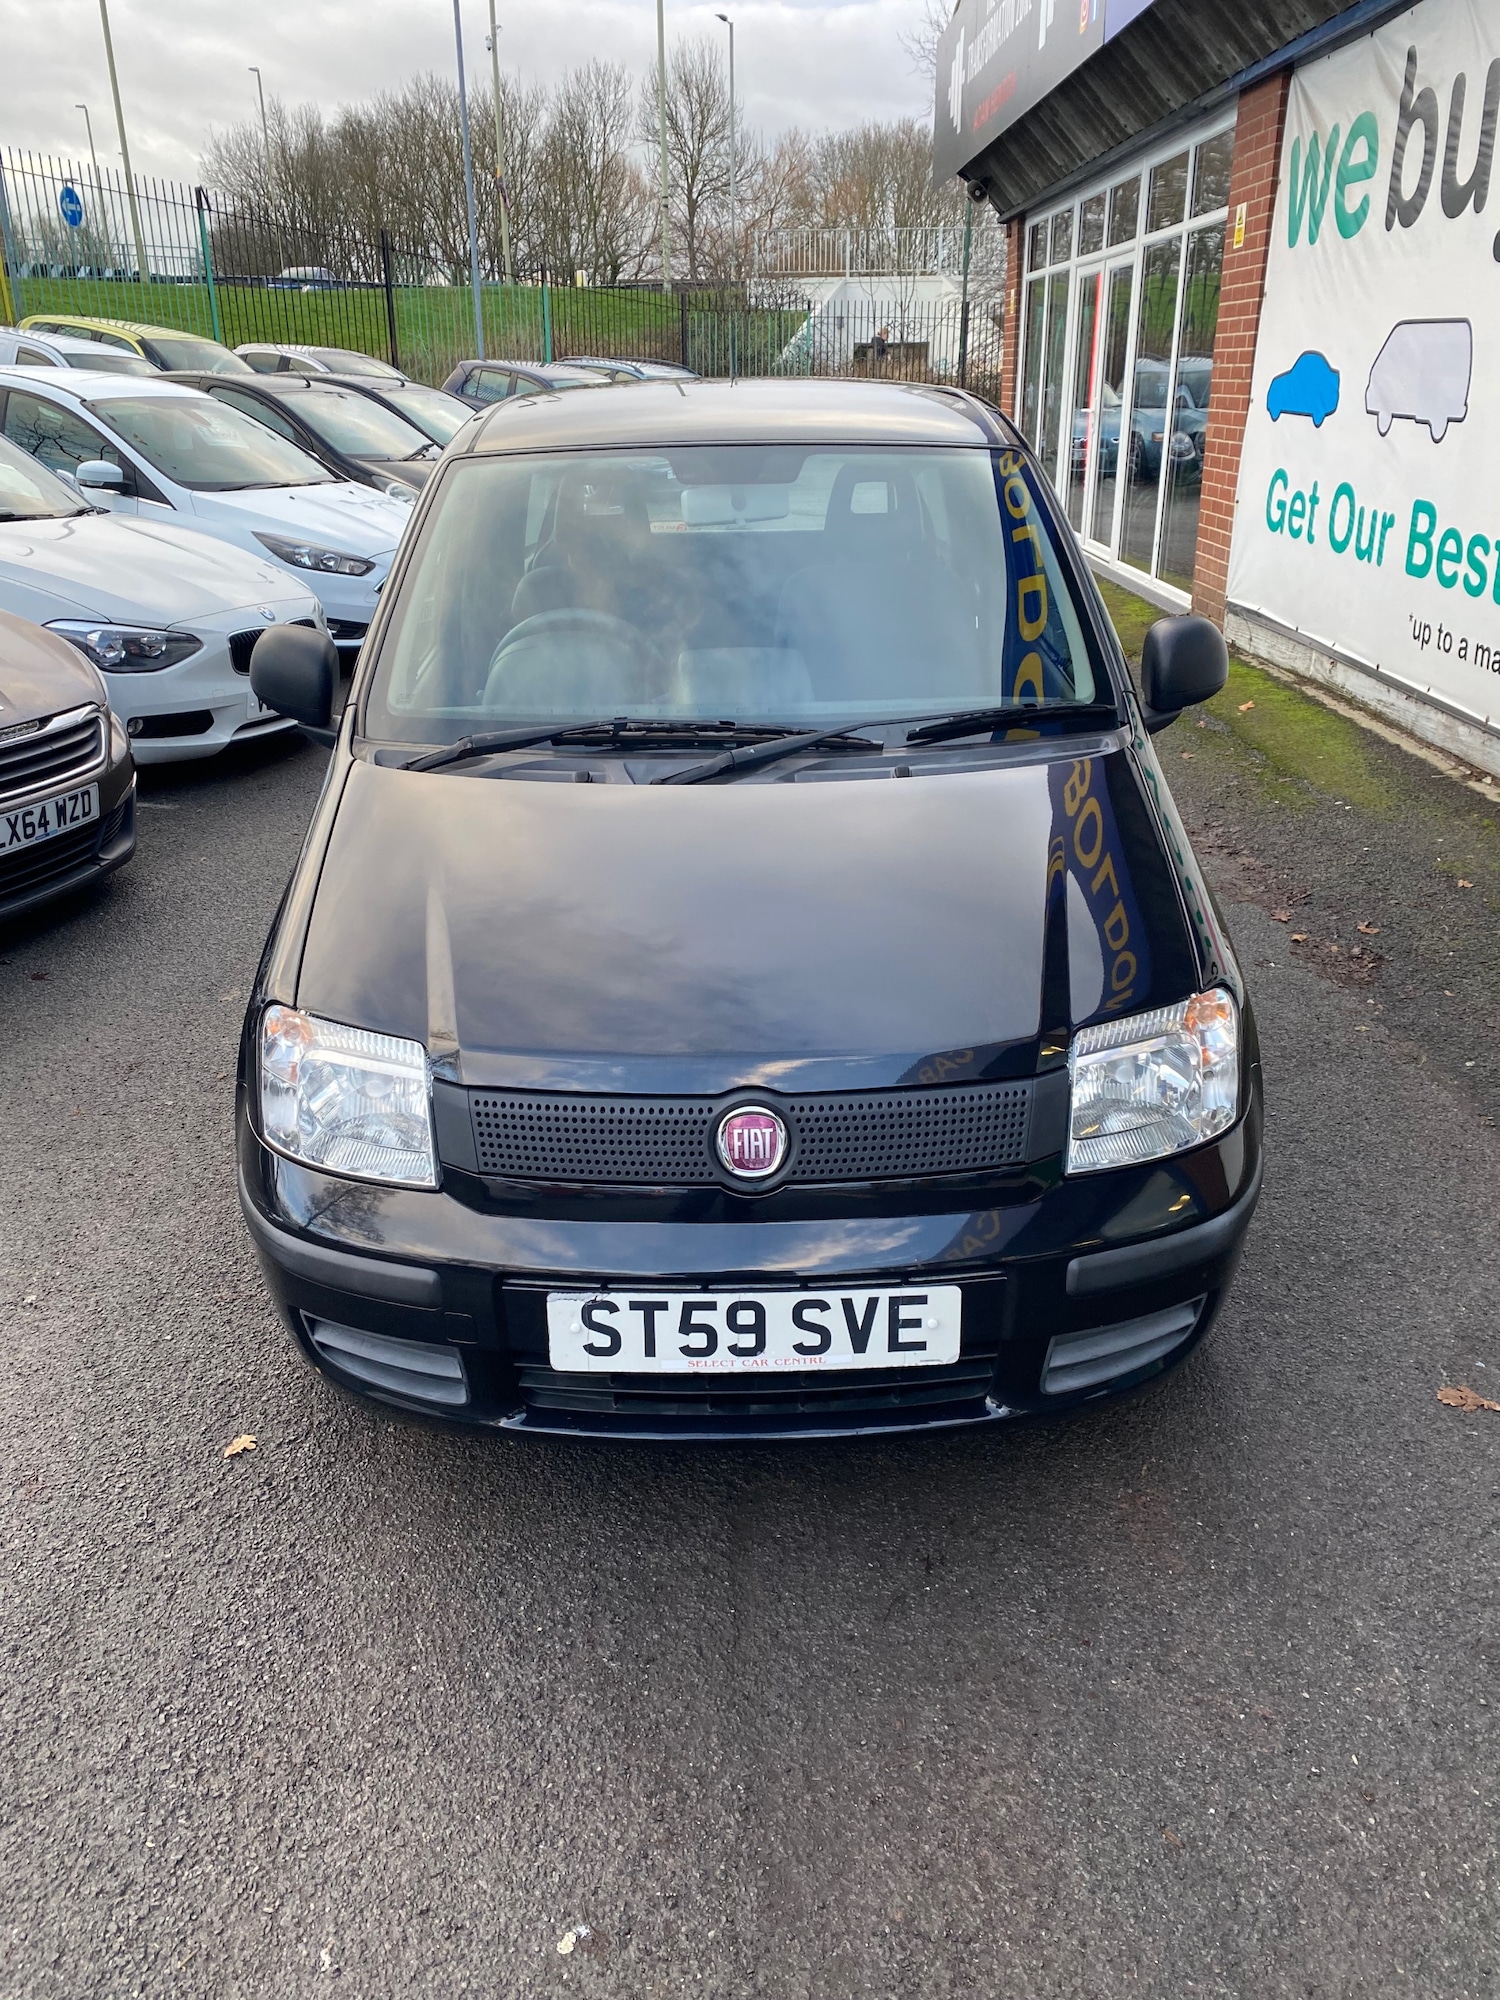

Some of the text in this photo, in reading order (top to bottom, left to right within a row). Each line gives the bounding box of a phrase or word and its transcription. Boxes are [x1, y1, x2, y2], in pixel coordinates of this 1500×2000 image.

[1385, 45, 1500, 262] bu
[1266, 467, 1320, 545] Get
[1328, 481, 1396, 567] Our
[1437, 622, 1453, 654] to
[1458, 636, 1469, 662] a
[55, 789, 92, 828] WZD
[733, 1127, 774, 1160] FIAT
[581, 1294, 929, 1358] ST59 SVE
[687, 1359, 737, 1368] SELECT
[741, 1358, 770, 1367] CAR
